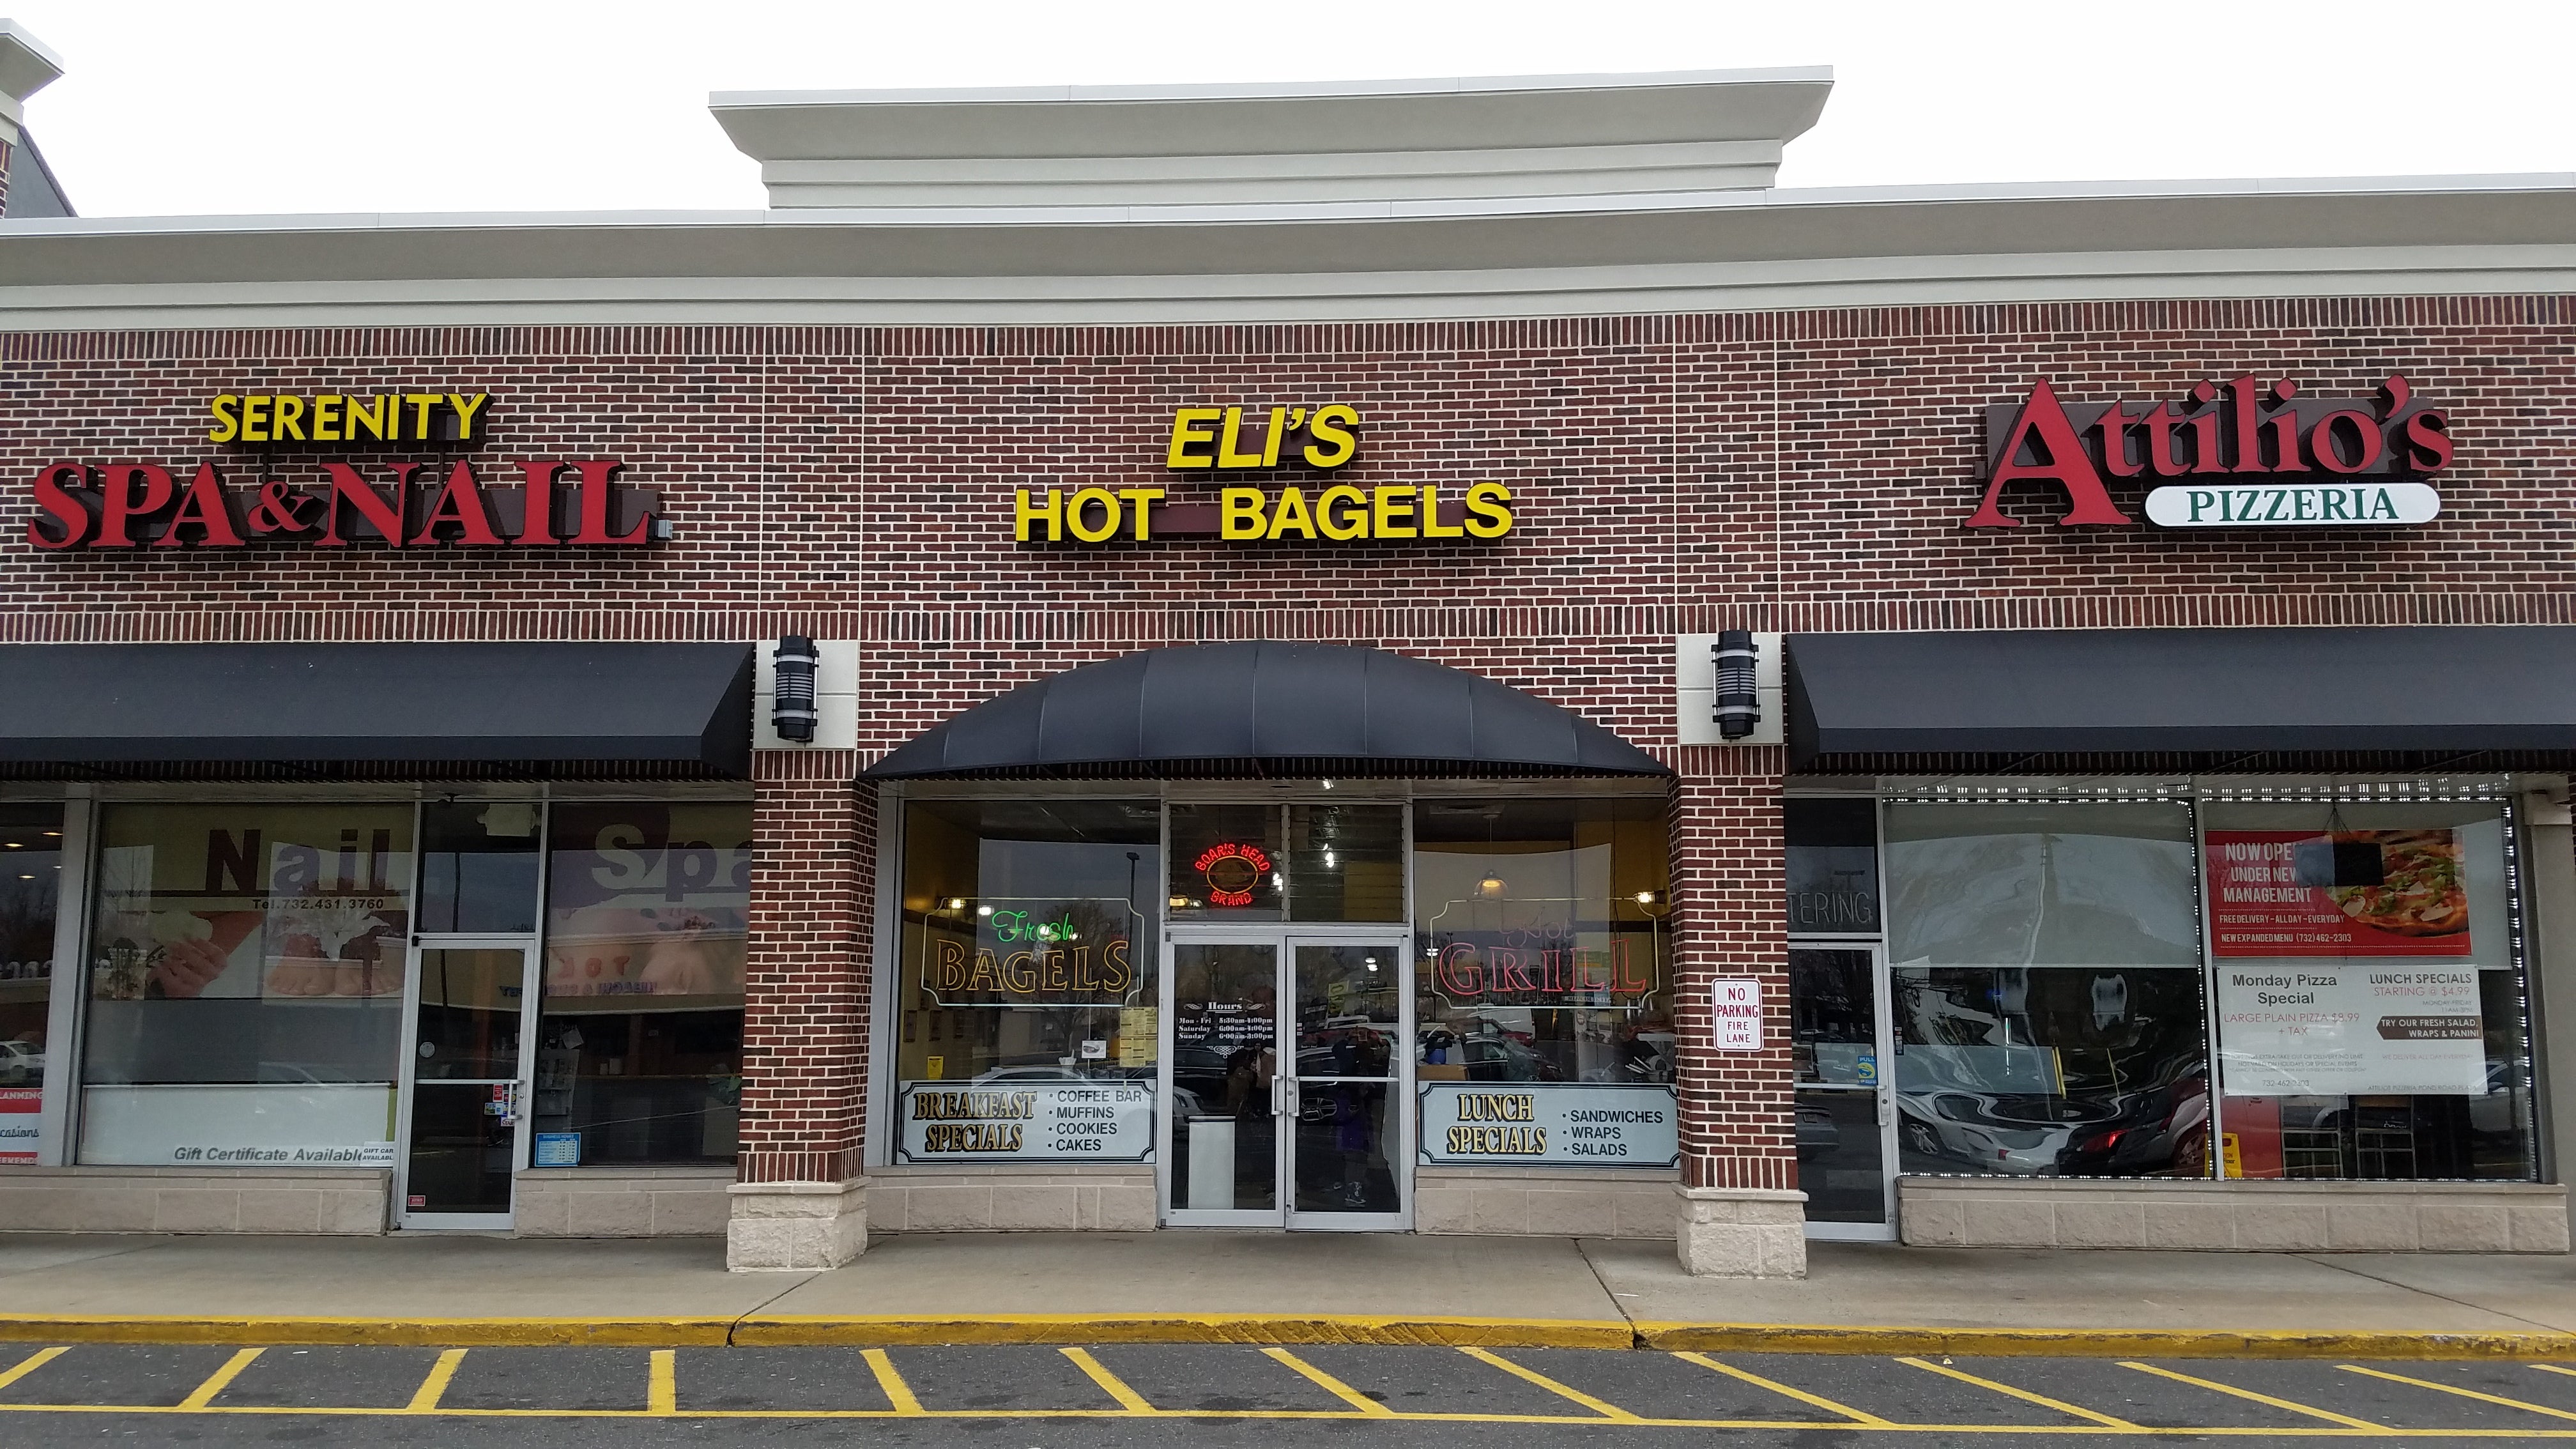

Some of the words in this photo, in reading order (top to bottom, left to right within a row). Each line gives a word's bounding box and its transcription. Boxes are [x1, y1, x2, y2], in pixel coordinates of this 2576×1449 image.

[208, 392, 491, 443] SERENITY
[1166, 404, 1360, 470] ELI'S
[1964, 373, 2455, 528] Attilio's
[27, 461, 246, 550] SPA
[248, 480, 314, 533] &
[313, 459, 650, 548] NAIL
[2186, 487, 2400, 523] PIZZERIA
[1015, 487, 1165, 543] HOT
[1222, 482, 1514, 542] BAGELS
[1195, 843, 1236, 870] BOAR'S
[1240, 844, 1270, 871] HEAD
[2225, 843, 2260, 861] NOW
[2264, 842, 2303, 861] OPE
[205, 829, 390, 891] Nail
[2230, 867, 2271, 882] UNDER
[1210, 891, 1253, 906] BRAND
[2223, 887, 2312, 902] MANAGEMENT
[1786, 893, 1871, 923] TERING
[992, 910, 1073, 942] Fresh
[2220, 915, 2237, 923] FREE
[2237, 915, 2269, 923] DELIVERY
[2275, 915, 2288, 923] ALL
[2288, 915, 2302, 923] DAY
[2308, 915, 2345, 923] EVERYDAY
[2221, 934, 2236, 942] NEW
[2237, 934, 2273, 942] EXPANDED
[2274, 934, 2294, 942] MENU
[936, 939, 1131, 993] BAGELS
[1439, 939, 1646, 995] GRILL
[2232, 974, 2291, 988] Monday
[2297, 974, 2337, 986] Pizza
[2370, 974, 2411, 984] LUNCH
[2416, 974, 2472, 984] SPECIALS
[1728, 988, 1745, 1000] NO
[2374, 987, 2425, 996] STARTING
[2441, 986, 2470, 997] $4.99
[1208, 1002, 1242, 1010] Hours
[2258, 992, 2314, 1006] Special
[1717, 1005, 1758, 1018] PARKING
[2225, 1013, 2261, 1022] LARGE
[2265, 1013, 2296, 1022] PLAIN
[2300, 1013, 2329, 1022] PIZZA
[2332, 1013, 2359, 1023] $8.99
[1728, 1022, 1748, 1030] FIRE
[2288, 1027, 2308, 1036] TAX
[1727, 1034, 1751, 1043] LANE
[2409, 1029, 2439, 1038] WRAPS
[2451, 1029, 2479, 1038] PANINI
[1057, 1090, 1110, 1102] COFFEE
[1116, 1091, 1142, 1102] BAR
[912, 1091, 1038, 1119] BREAKFAST
[1457, 1094, 1535, 1122] LUNCH
[1057, 1107, 1114, 1118] MUFFINS
[1570, 1110, 1663, 1123] SANDWICHES
[1057, 1123, 1117, 1135] COOKIES
[1571, 1126, 1621, 1139] WRAPS
[924, 1124, 1023, 1152] SPECIALS
[1056, 1138, 1101, 1151] CAKES
[1446, 1126, 1547, 1155] SPECIALS
[174, 1147, 202, 1160] Gift
[207, 1147, 288, 1160] Certificate
[1572, 1143, 1627, 1156] SALADS
